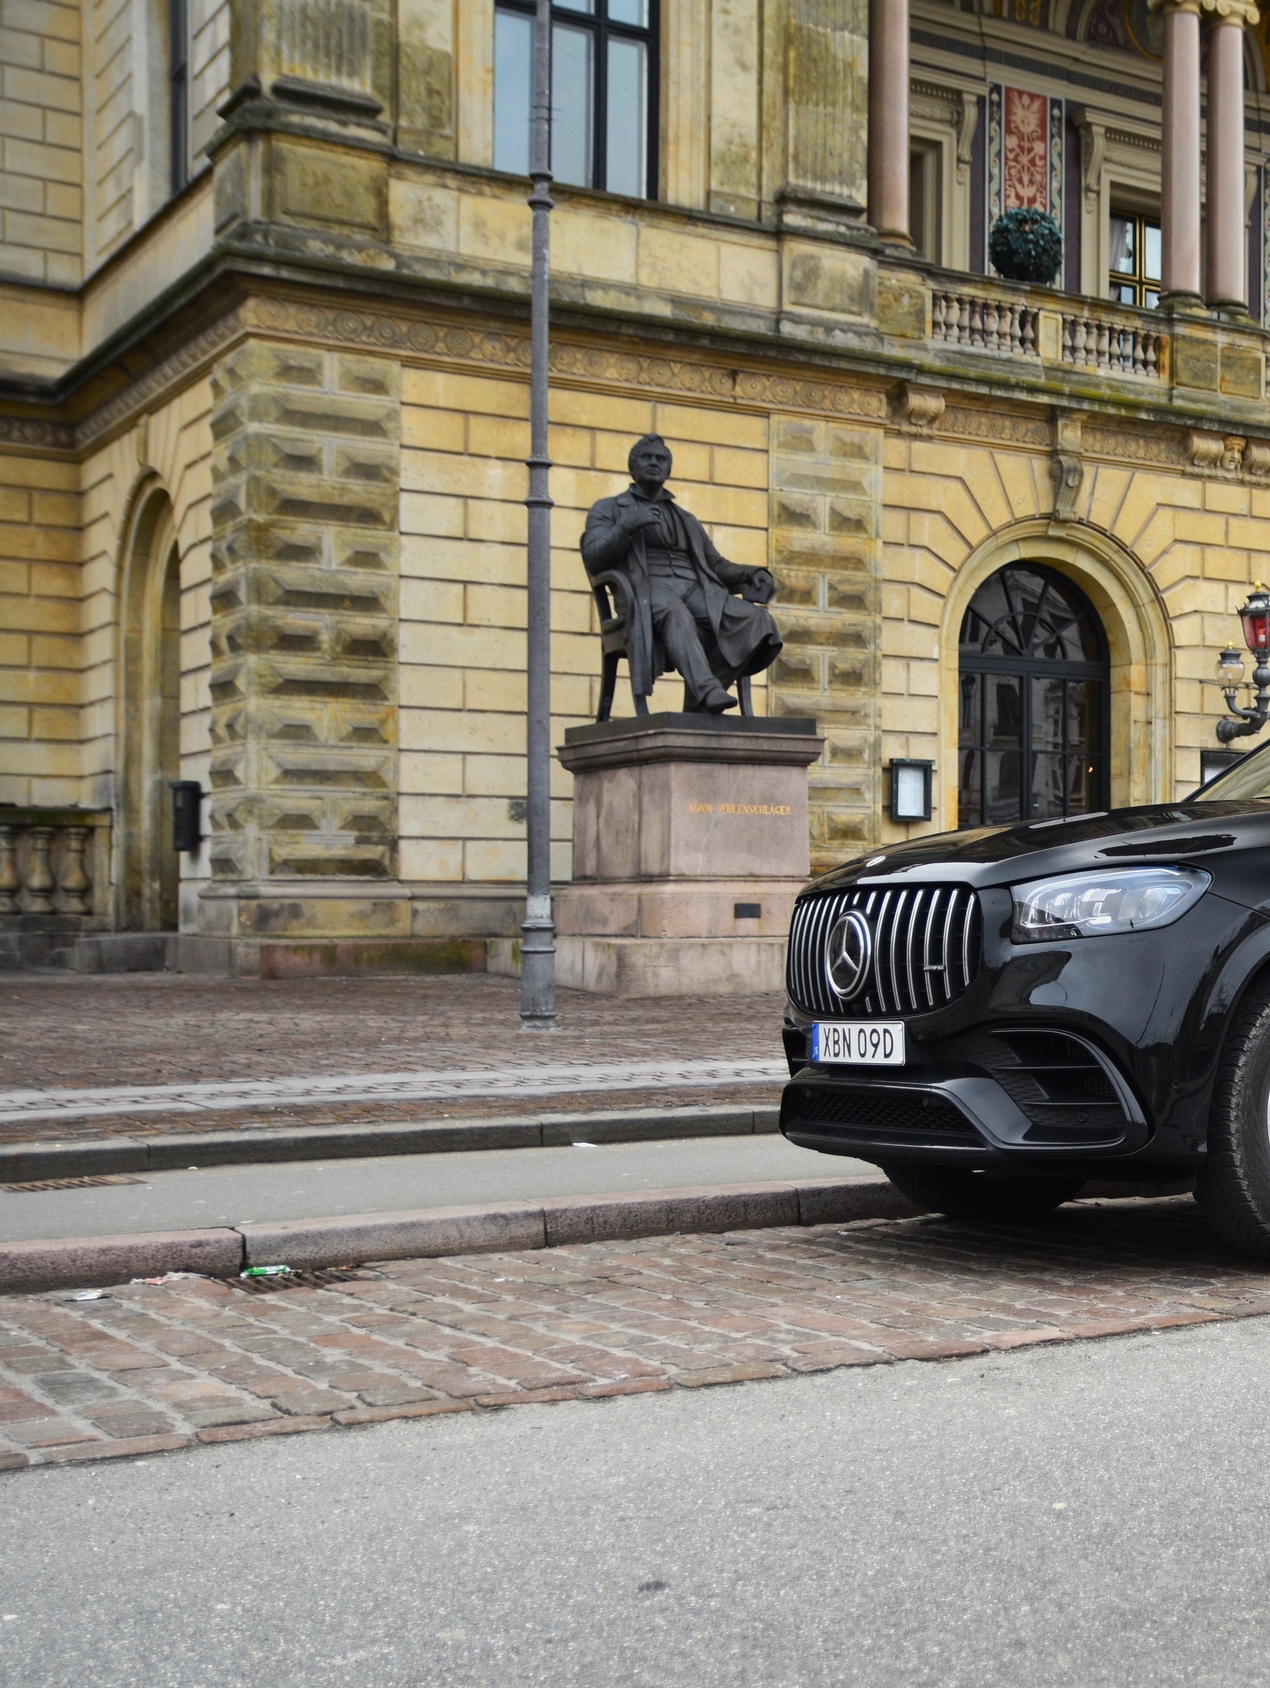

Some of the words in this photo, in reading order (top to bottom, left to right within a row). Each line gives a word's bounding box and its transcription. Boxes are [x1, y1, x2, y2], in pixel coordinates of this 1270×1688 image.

[689, 803, 712, 813] ADAM
[823, 1027, 852, 1058] XBN
[857, 1027, 894, 1059] 09D
